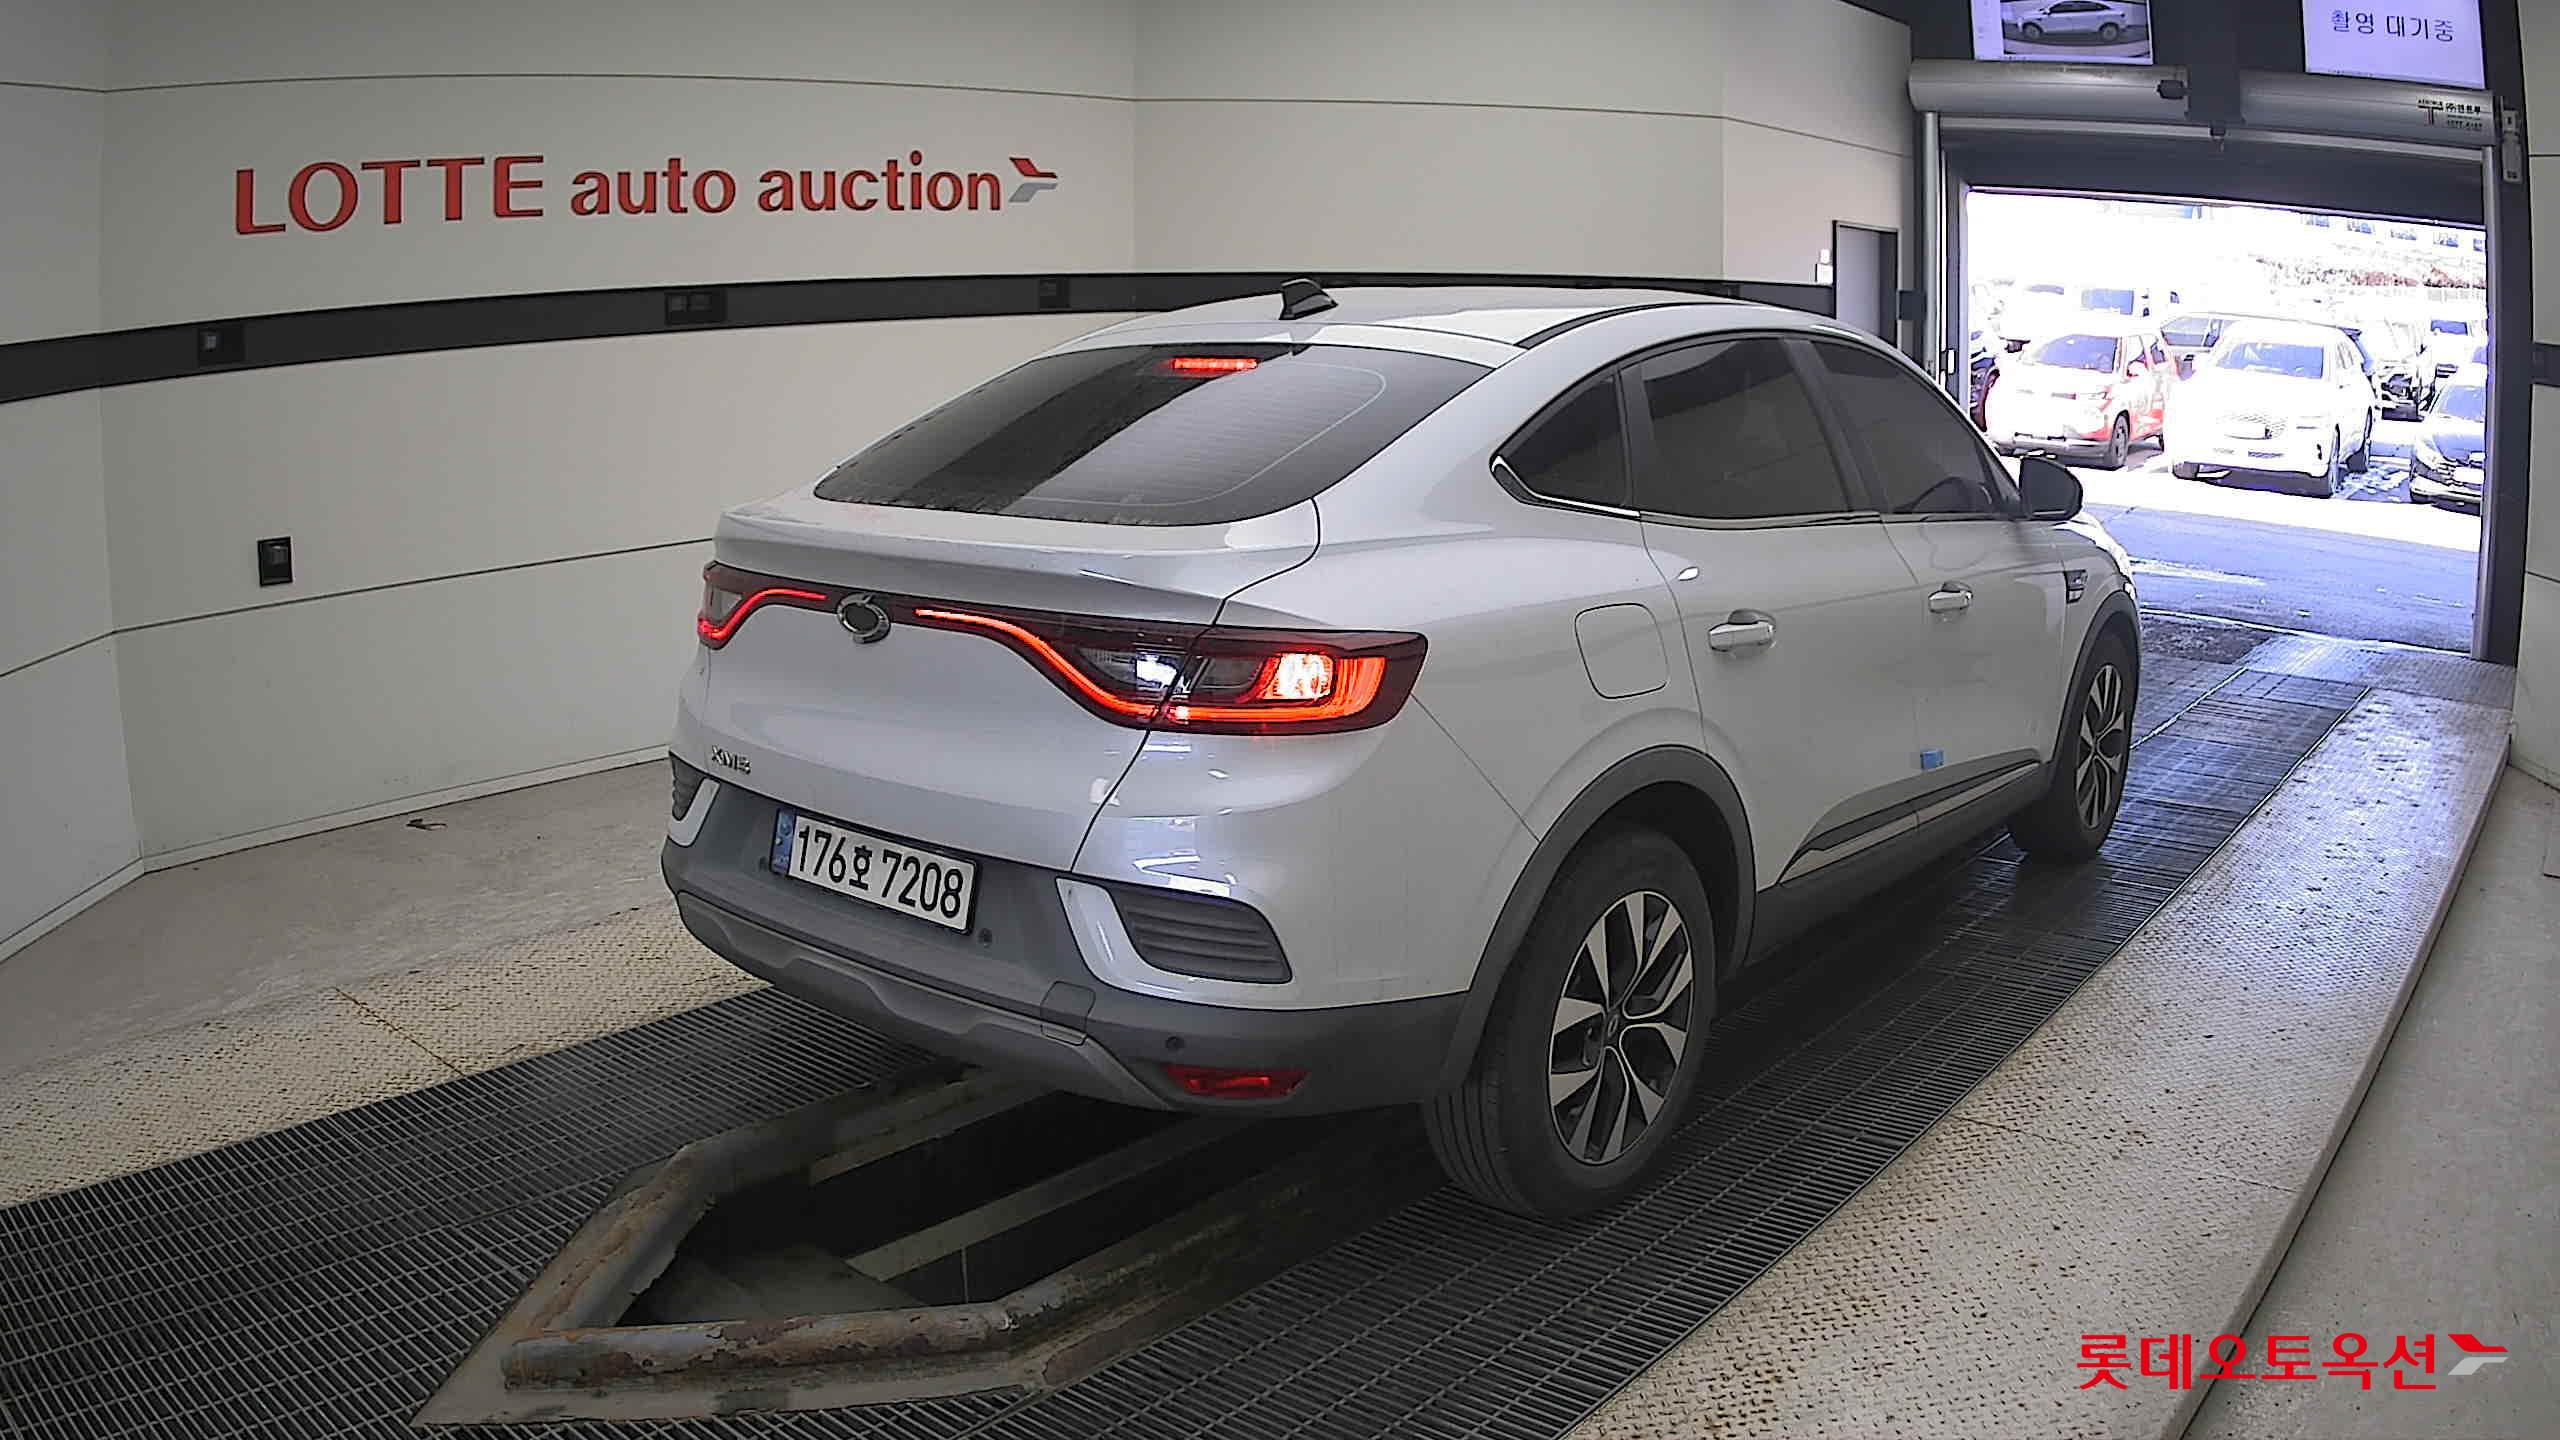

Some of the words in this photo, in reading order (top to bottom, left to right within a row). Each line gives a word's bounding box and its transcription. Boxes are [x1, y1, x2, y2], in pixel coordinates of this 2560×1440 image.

[2331, 9, 2375, 35] 촬영
[235, 154, 544, 236] LOTTE
[569, 157, 737, 217] auto
[758, 149, 1001, 213] auction
[798, 825, 873, 891] 176호
[881, 848, 965, 919] 7208
